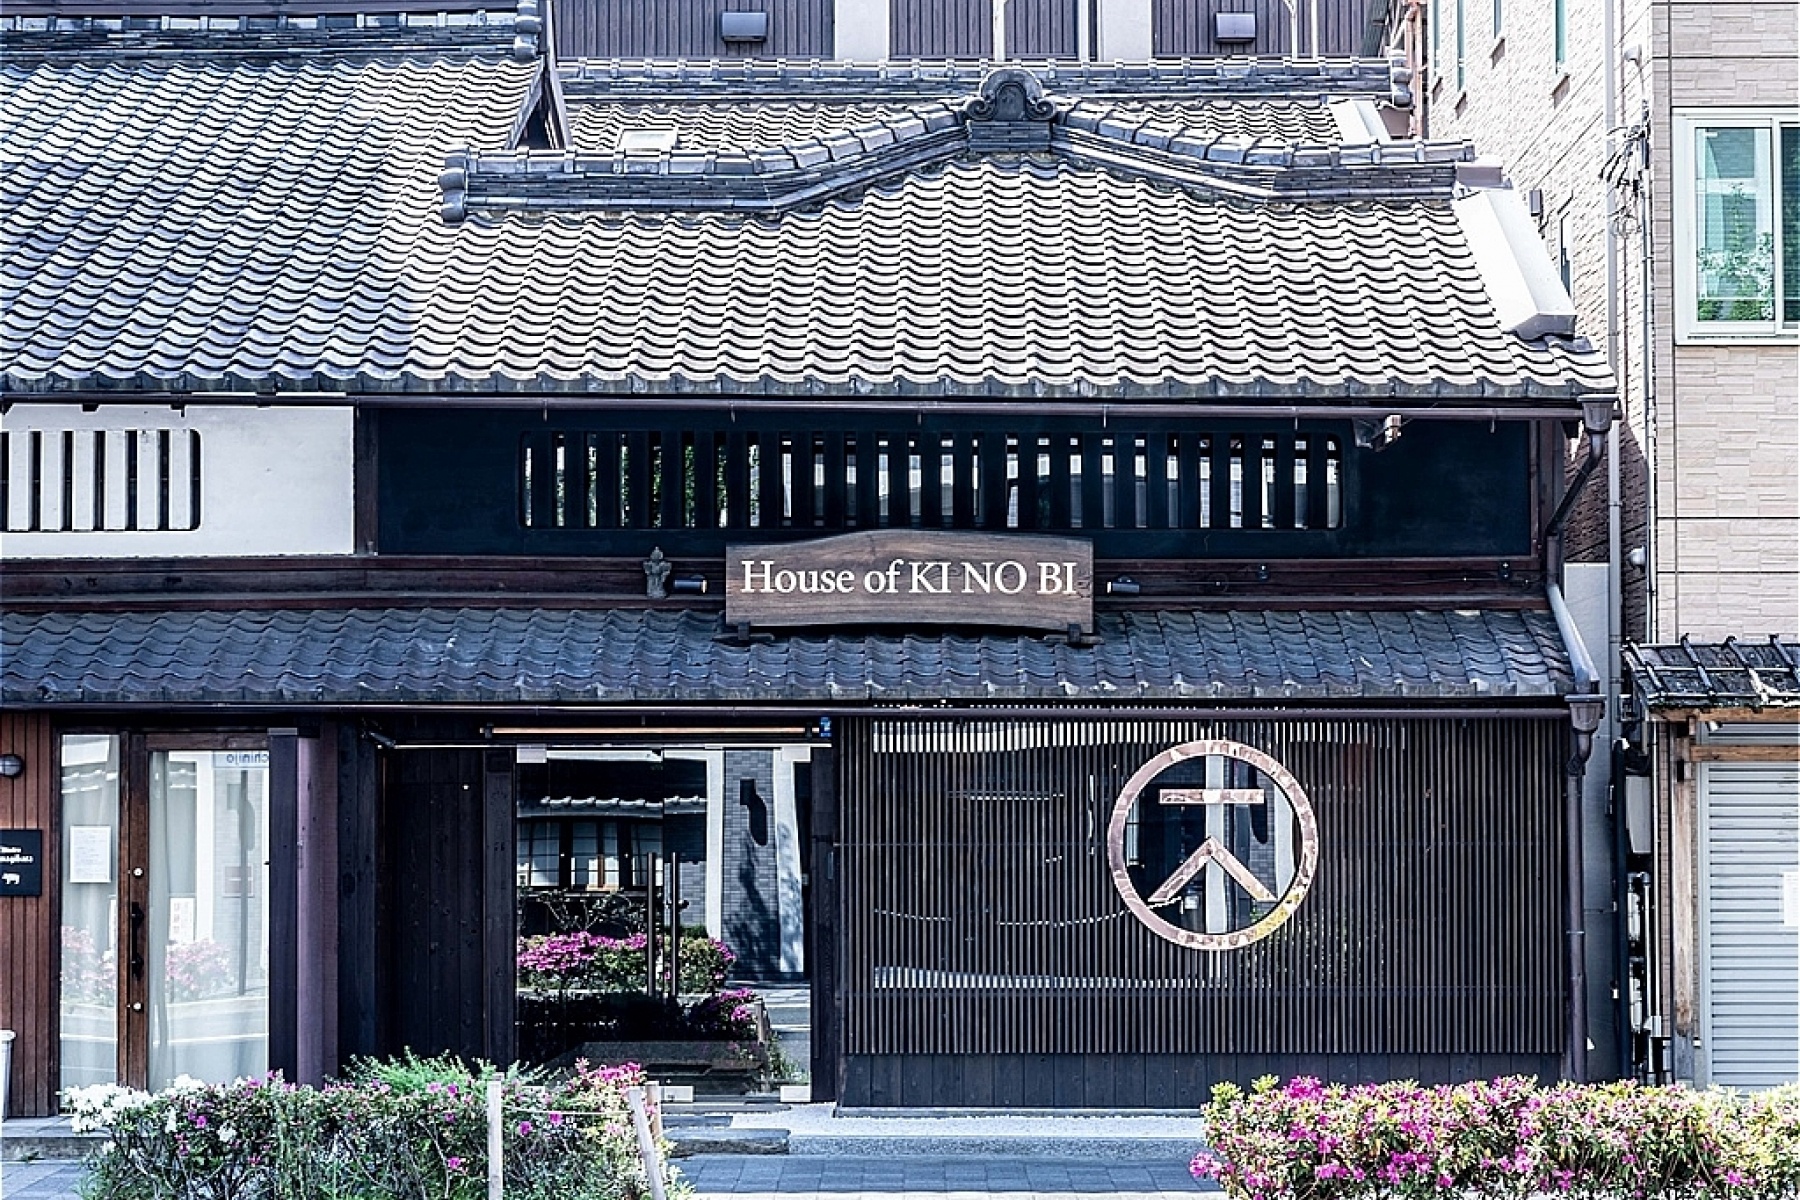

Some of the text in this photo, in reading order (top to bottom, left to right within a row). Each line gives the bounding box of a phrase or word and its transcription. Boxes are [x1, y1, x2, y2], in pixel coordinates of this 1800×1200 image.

[741, 559, 1077, 595] House of KI NO BI
